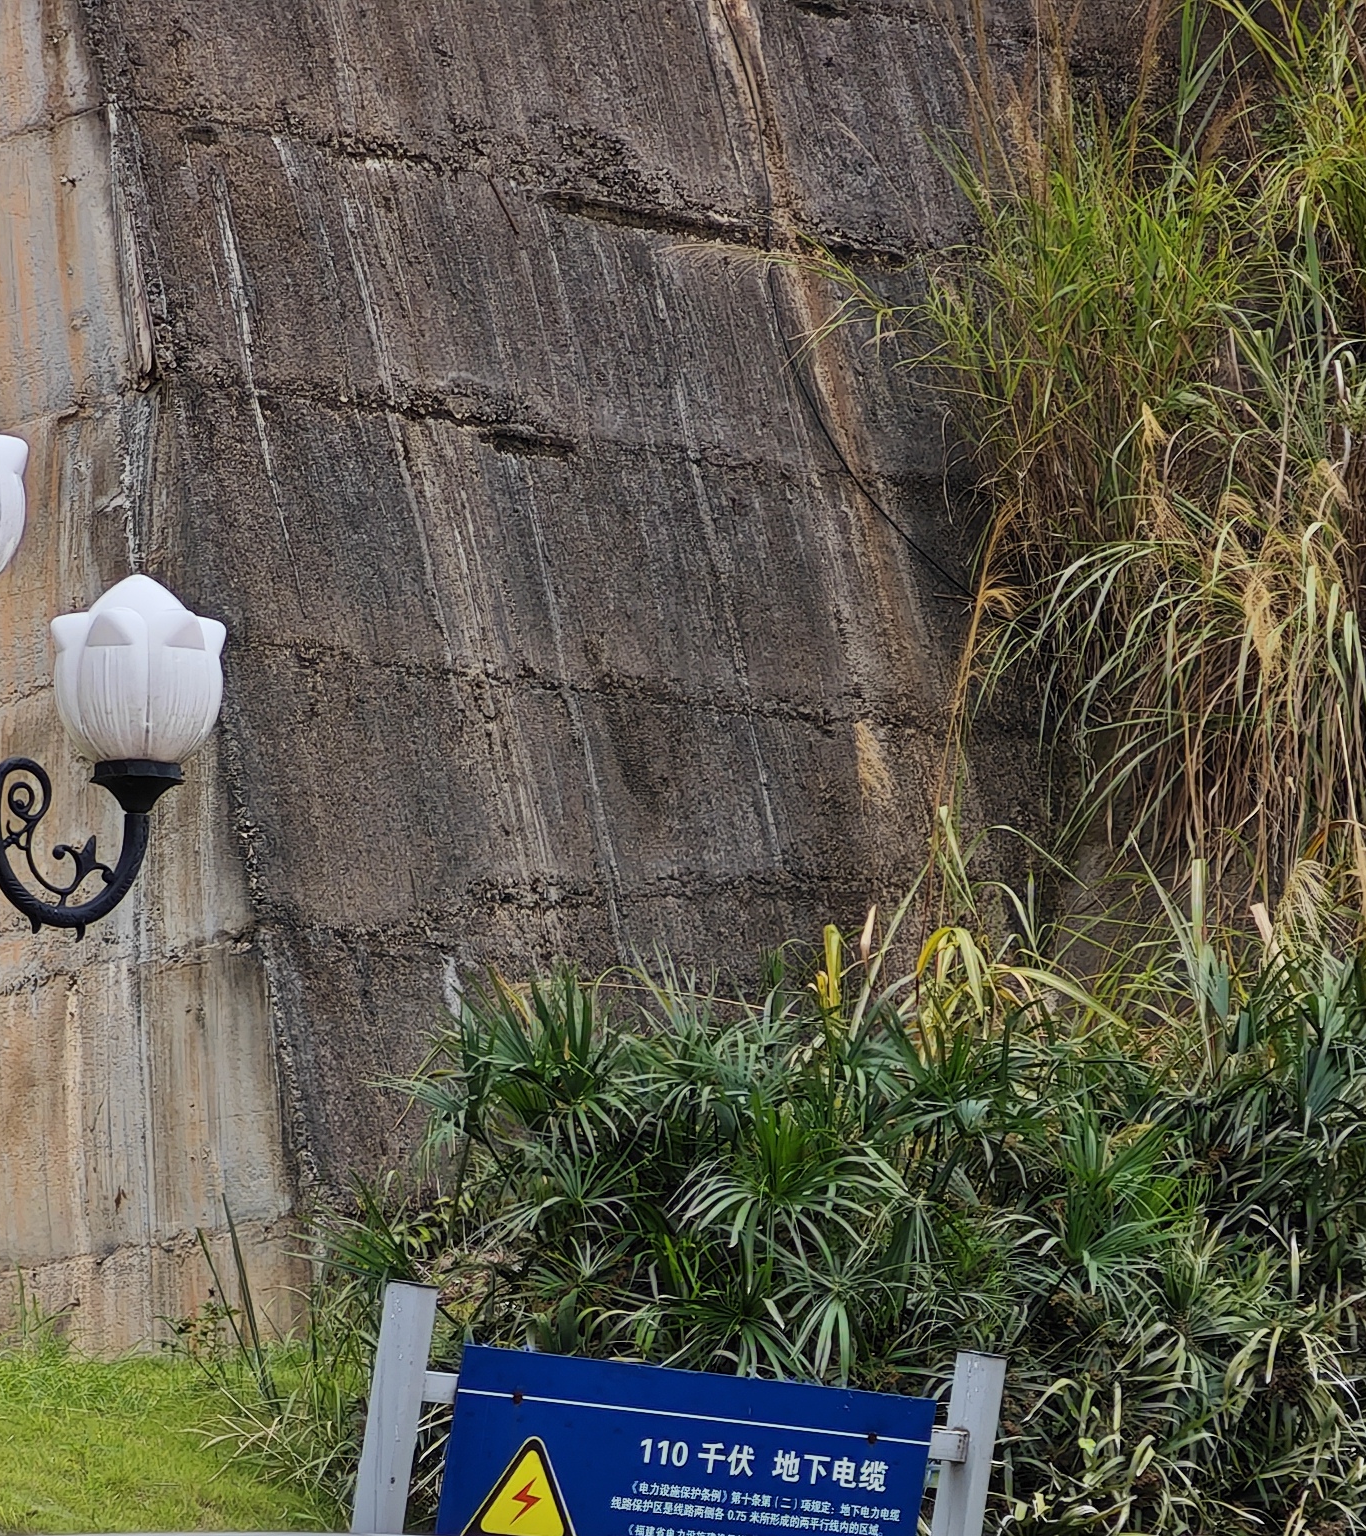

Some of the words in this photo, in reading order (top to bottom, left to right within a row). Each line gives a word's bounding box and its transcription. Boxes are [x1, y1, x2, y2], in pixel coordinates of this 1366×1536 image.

[640, 1438, 689, 1467] 110
[697, 1442, 756, 1477] 千伏
[771, 1449, 889, 1493] 地下电缆
